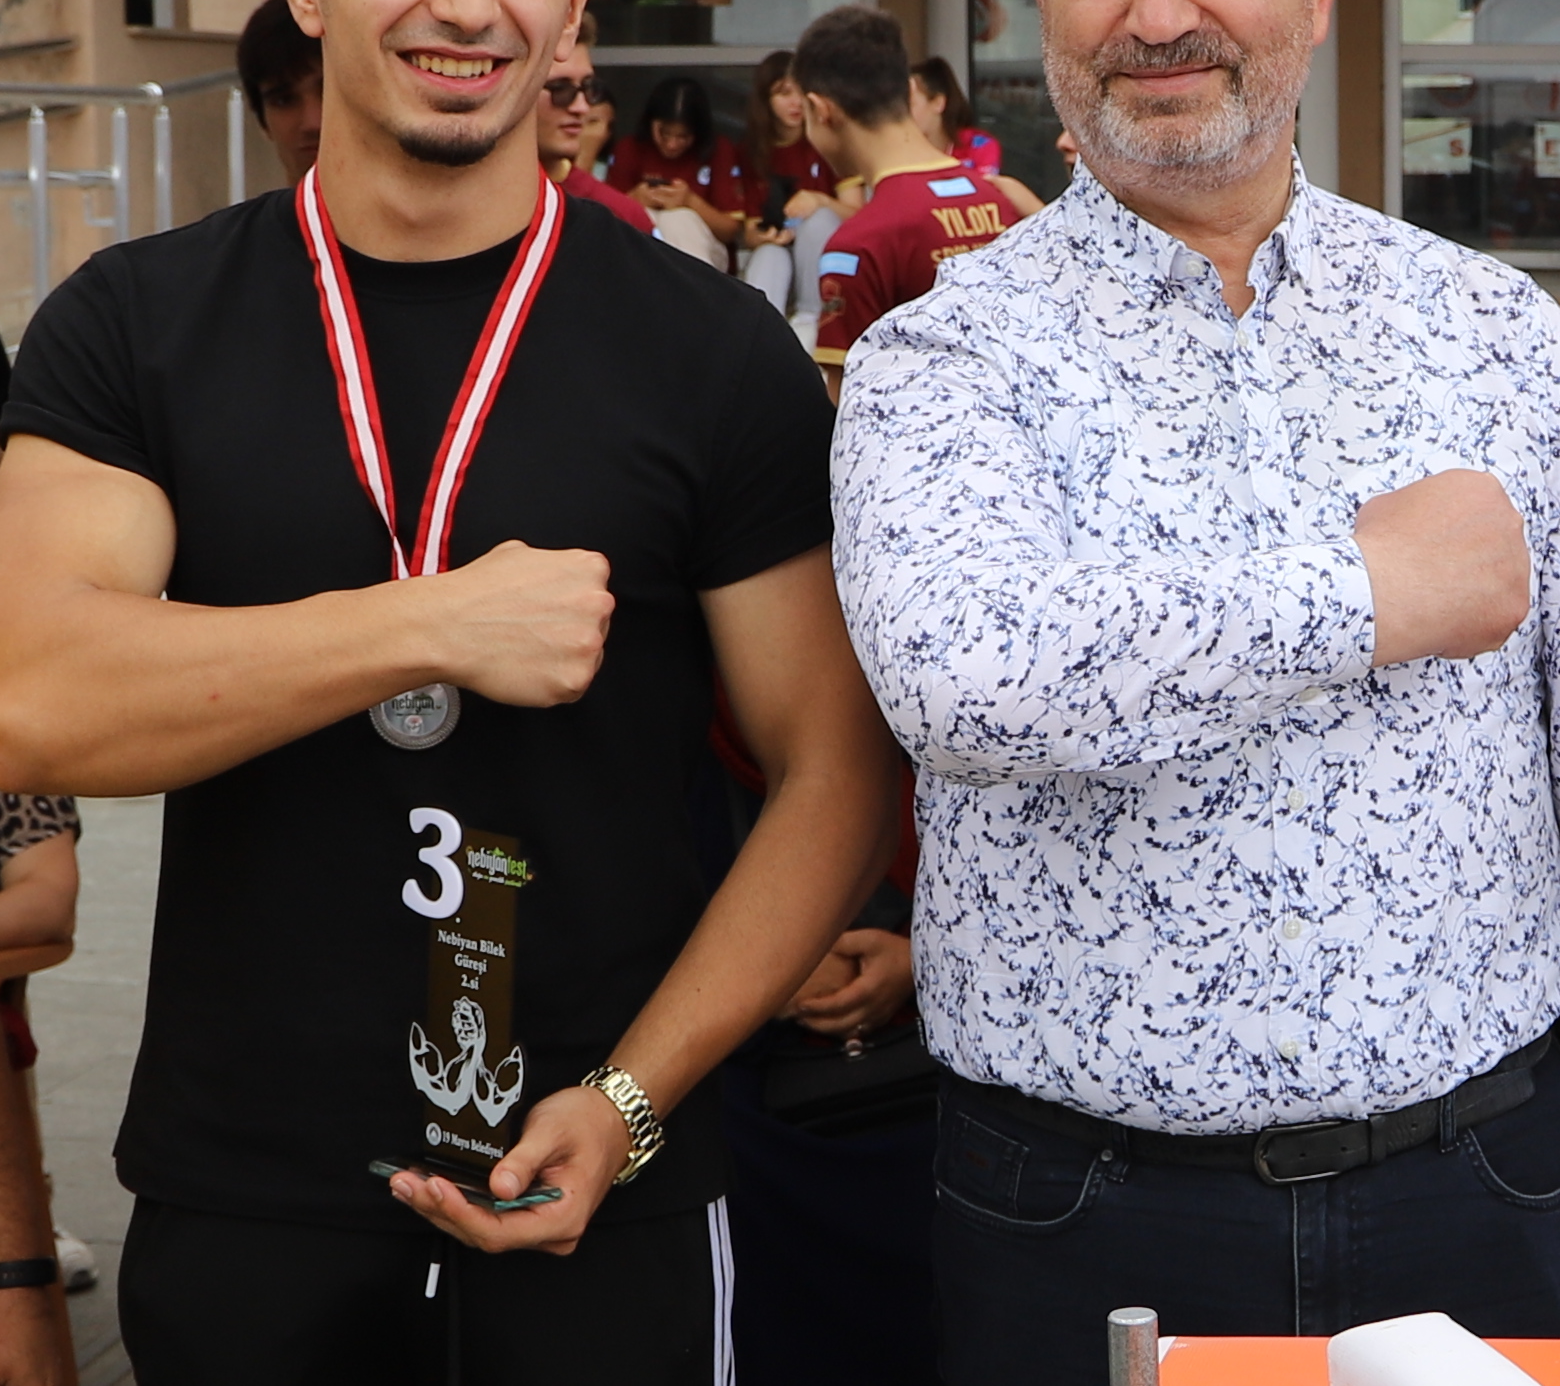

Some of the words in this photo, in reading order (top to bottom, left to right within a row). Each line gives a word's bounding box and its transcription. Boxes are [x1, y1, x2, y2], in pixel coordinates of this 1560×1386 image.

[930, 202, 1007, 239] YILDIZ
[437, 929, 479, 952] Nebiyan
[479, 939, 506, 958] Bilek
[454, 953, 488, 976] Güreşi
